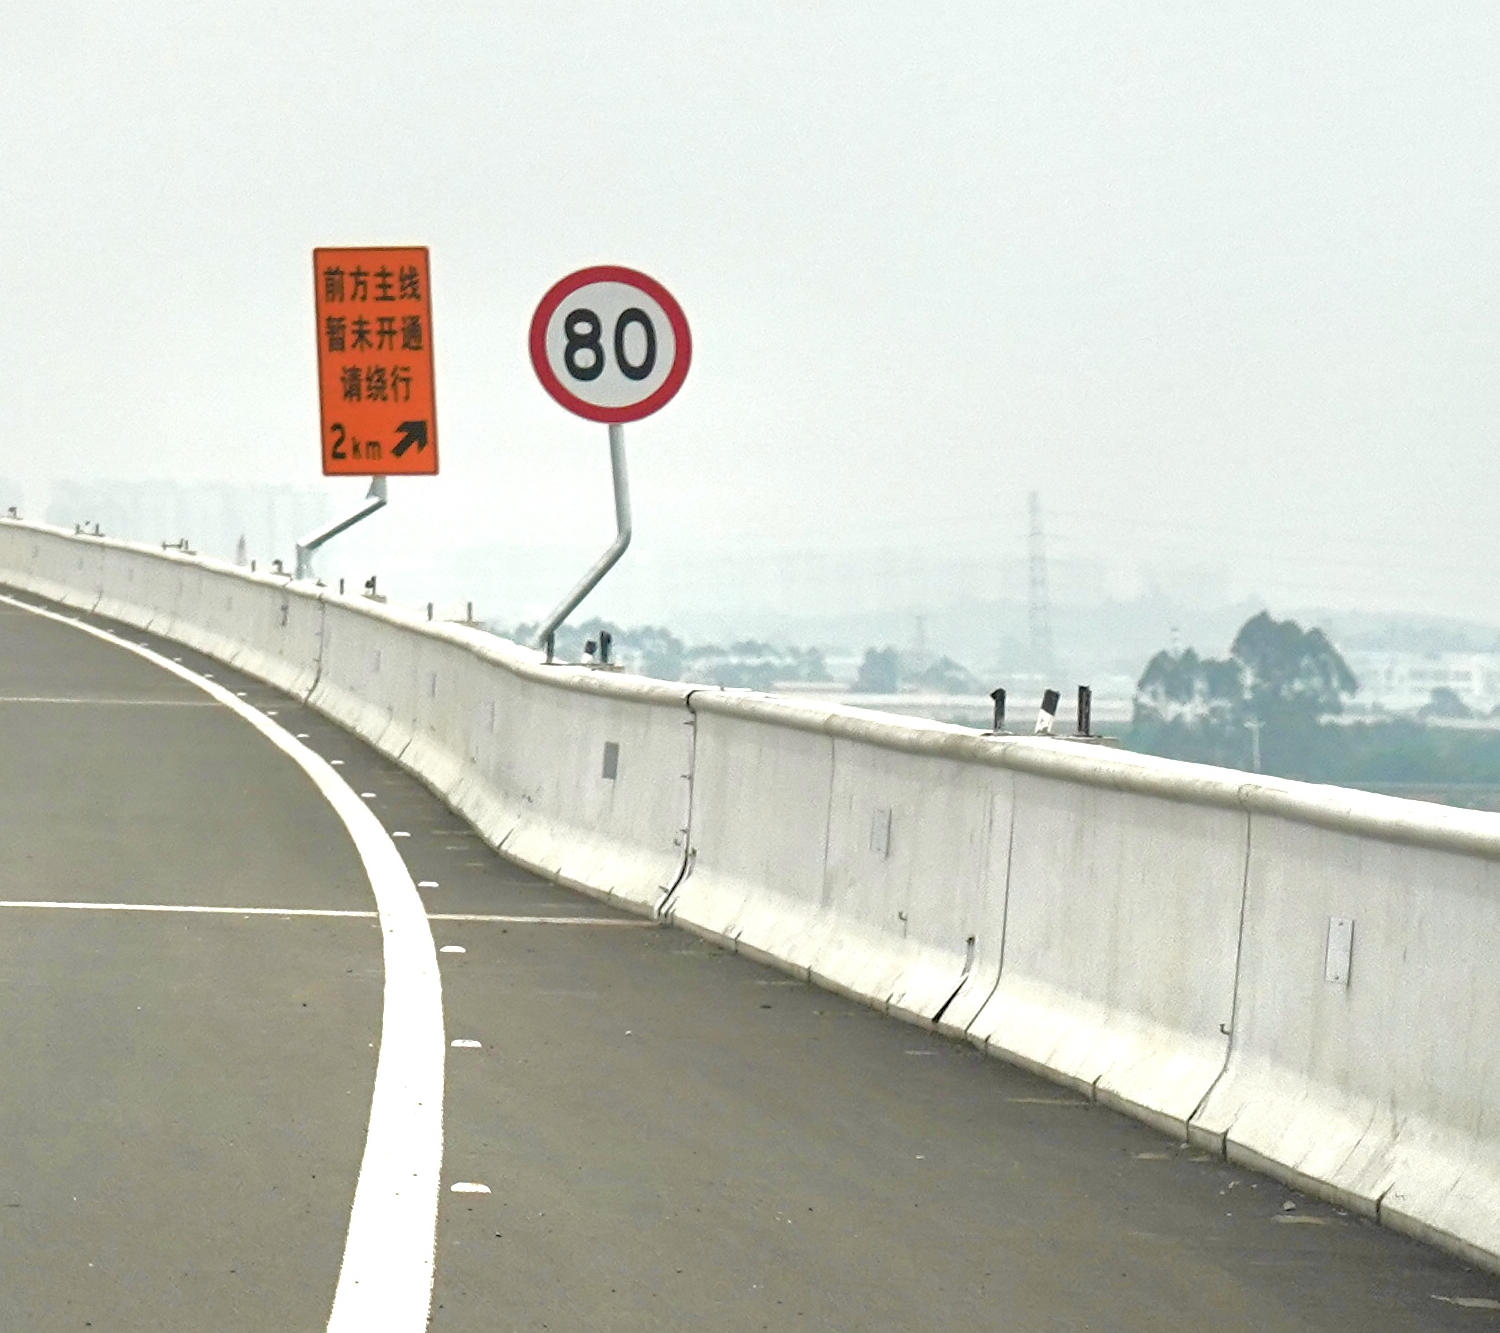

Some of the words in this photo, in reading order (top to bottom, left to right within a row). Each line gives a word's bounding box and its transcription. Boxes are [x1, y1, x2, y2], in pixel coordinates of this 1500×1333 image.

[323, 264, 422, 304] 前方主线
[325, 313, 425, 353] 暂未开通
[564, 307, 657, 382] 80
[340, 364, 413, 403] 请绕行
